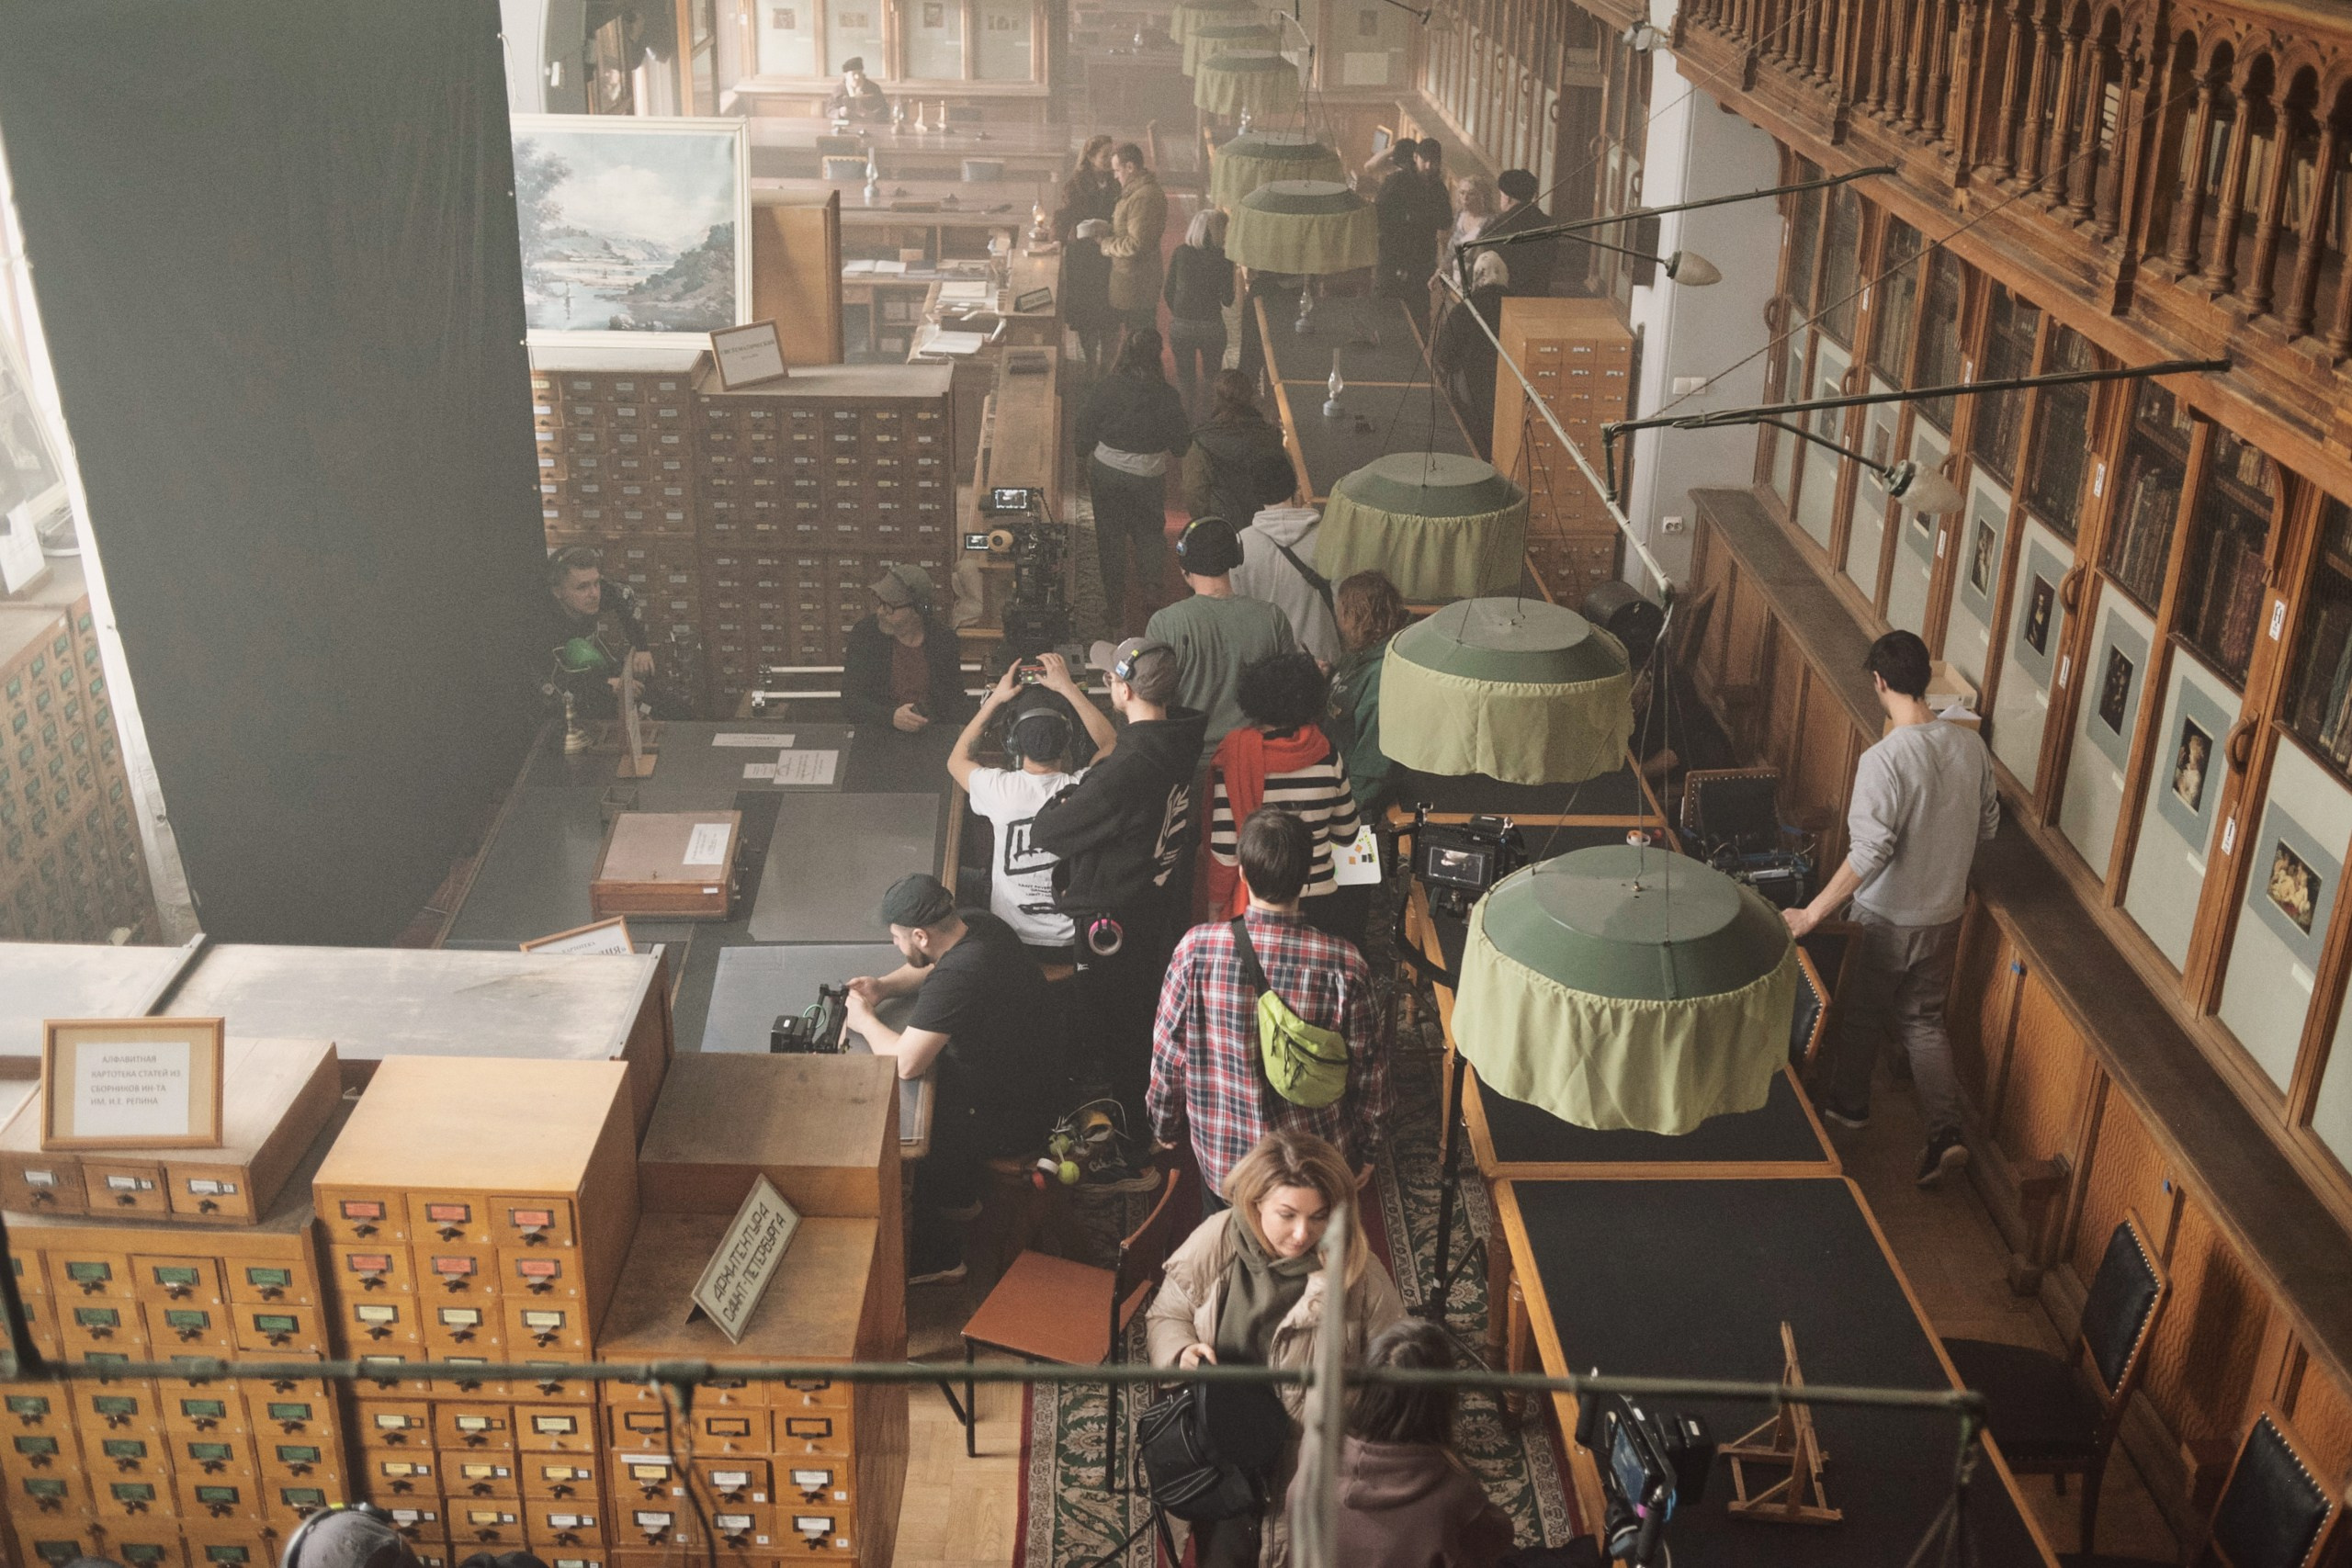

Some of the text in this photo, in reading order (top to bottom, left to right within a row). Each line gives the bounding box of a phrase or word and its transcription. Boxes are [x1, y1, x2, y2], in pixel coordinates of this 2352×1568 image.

[102, 1055, 156, 1064] АЛФАВИТНАЯ
[91, 1068, 181, 1078] КАРТОТЕКА СТАТЕЙ ИЗ
[91, 1084, 166, 1093] СБОРНИКОВ ИН-ТА
[126, 1097, 158, 1105] РЕПИНА
[714, 1201, 769, 1303] АРХИТЕКТУРА
[723, 1212, 786, 1323] САНКТ-ПЕТЕРБУРГА
